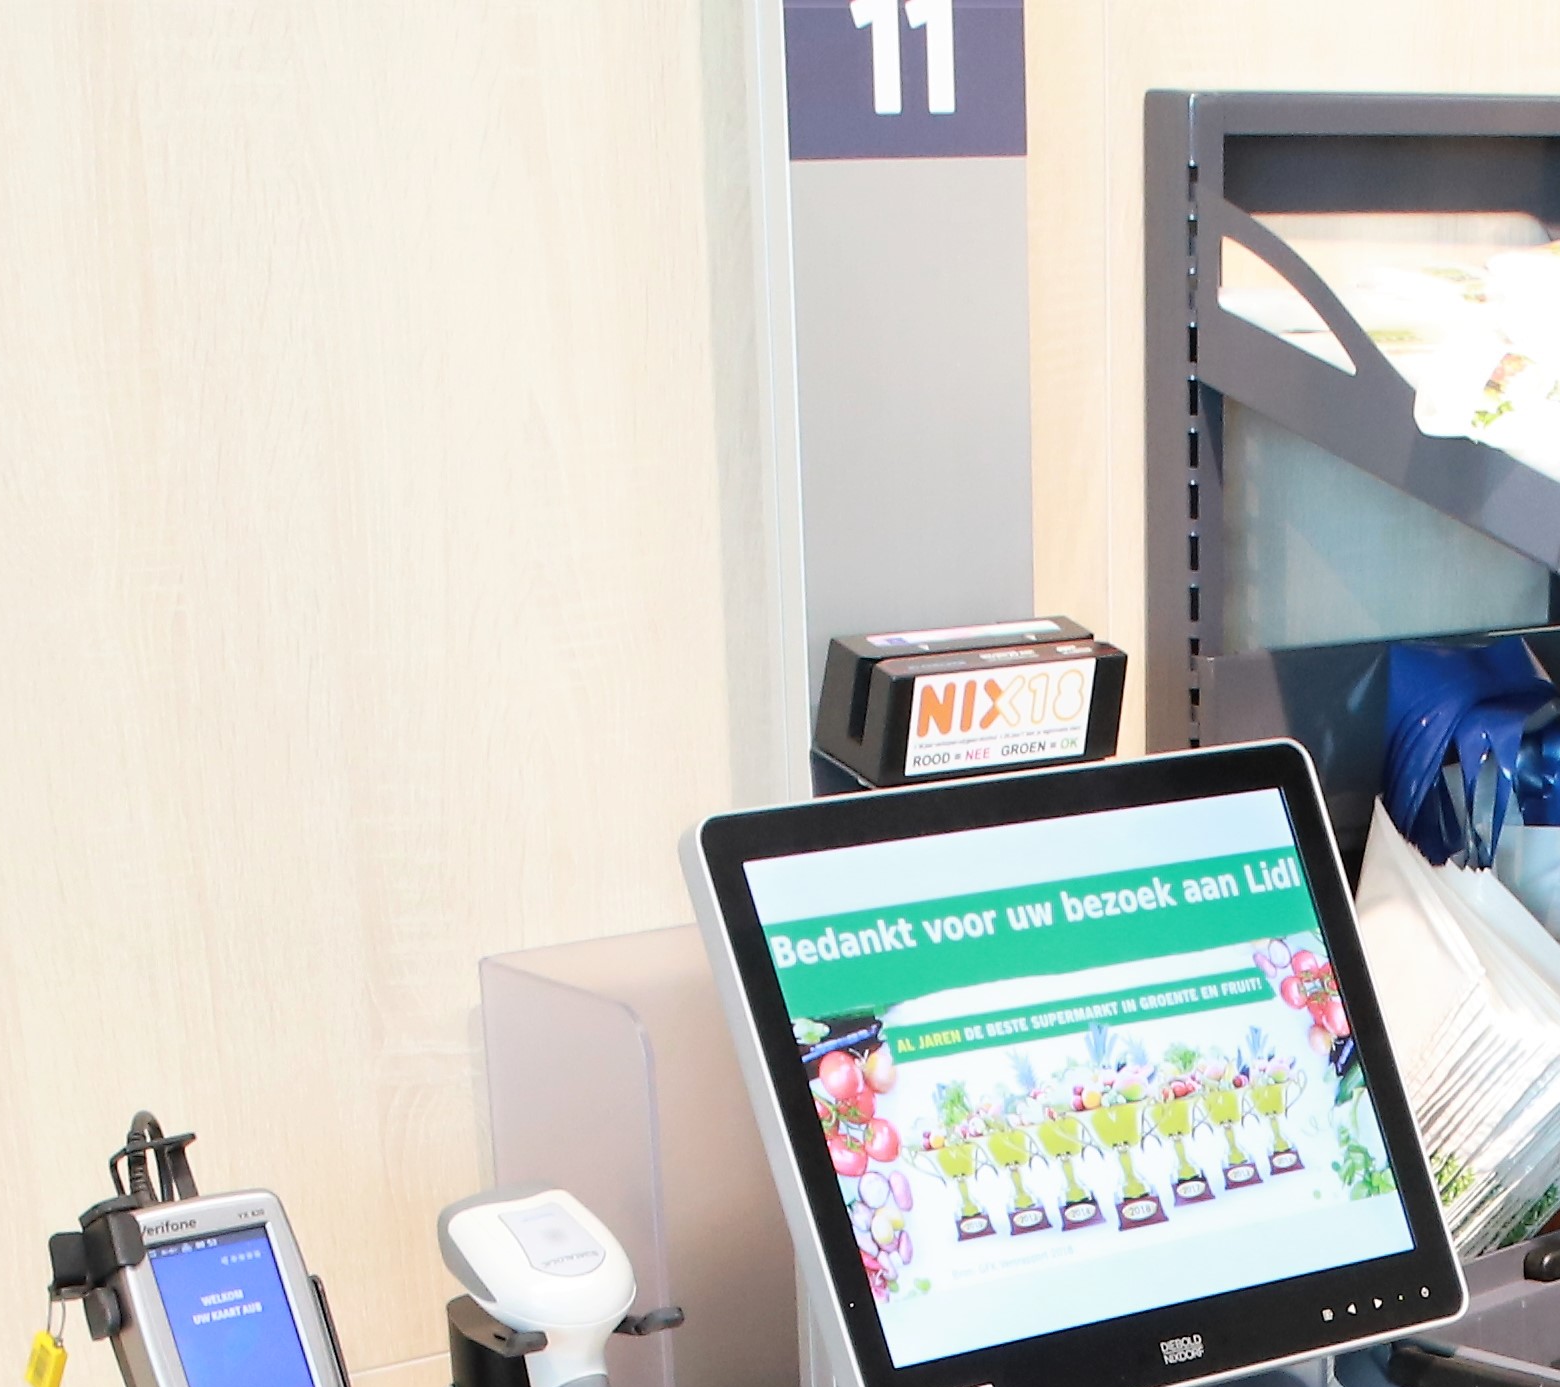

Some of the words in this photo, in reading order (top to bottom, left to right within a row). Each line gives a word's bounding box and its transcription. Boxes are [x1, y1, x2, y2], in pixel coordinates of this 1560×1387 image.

[849, 0, 956, 115] 11
[912, 751, 950, 768] ROOD
[964, 747, 990, 761] NEE
[1001, 740, 1046, 757] GROEN
[1060, 737, 1079, 750] OK
[770, 917, 916, 968] Bedankt
[922, 909, 997, 944] voor
[1006, 901, 1054, 931] uw
[1059, 877, 1178, 923] bezoek
[1182, 873, 1240, 904] aan
[1243, 857, 1301, 894] Lidl
[897, 1038, 916, 1053] AL
[919, 1029, 961, 1050] JAREN
[963, 1024, 984, 1041] DE
[985, 1017, 1029, 1038] BESTE
[1030, 1001, 1119, 1029] SUPERMARKT
[1121, 998, 1137, 1014] IN
[1140, 987, 1199, 1011] GROENTE
[1200, 984, 1219, 1000] EN
[1220, 977, 1263, 997] FRUIT!
[200, 1288, 245, 1307] WELKOM
[192, 1313, 211, 1326] UW
[210, 1306, 241, 1322] KAART
[242, 1301, 263, 1316] AUB
[1160, 1333, 1202, 1352] DIEBOLD
[1163, 1347, 1204, 1365] NIXDORF
